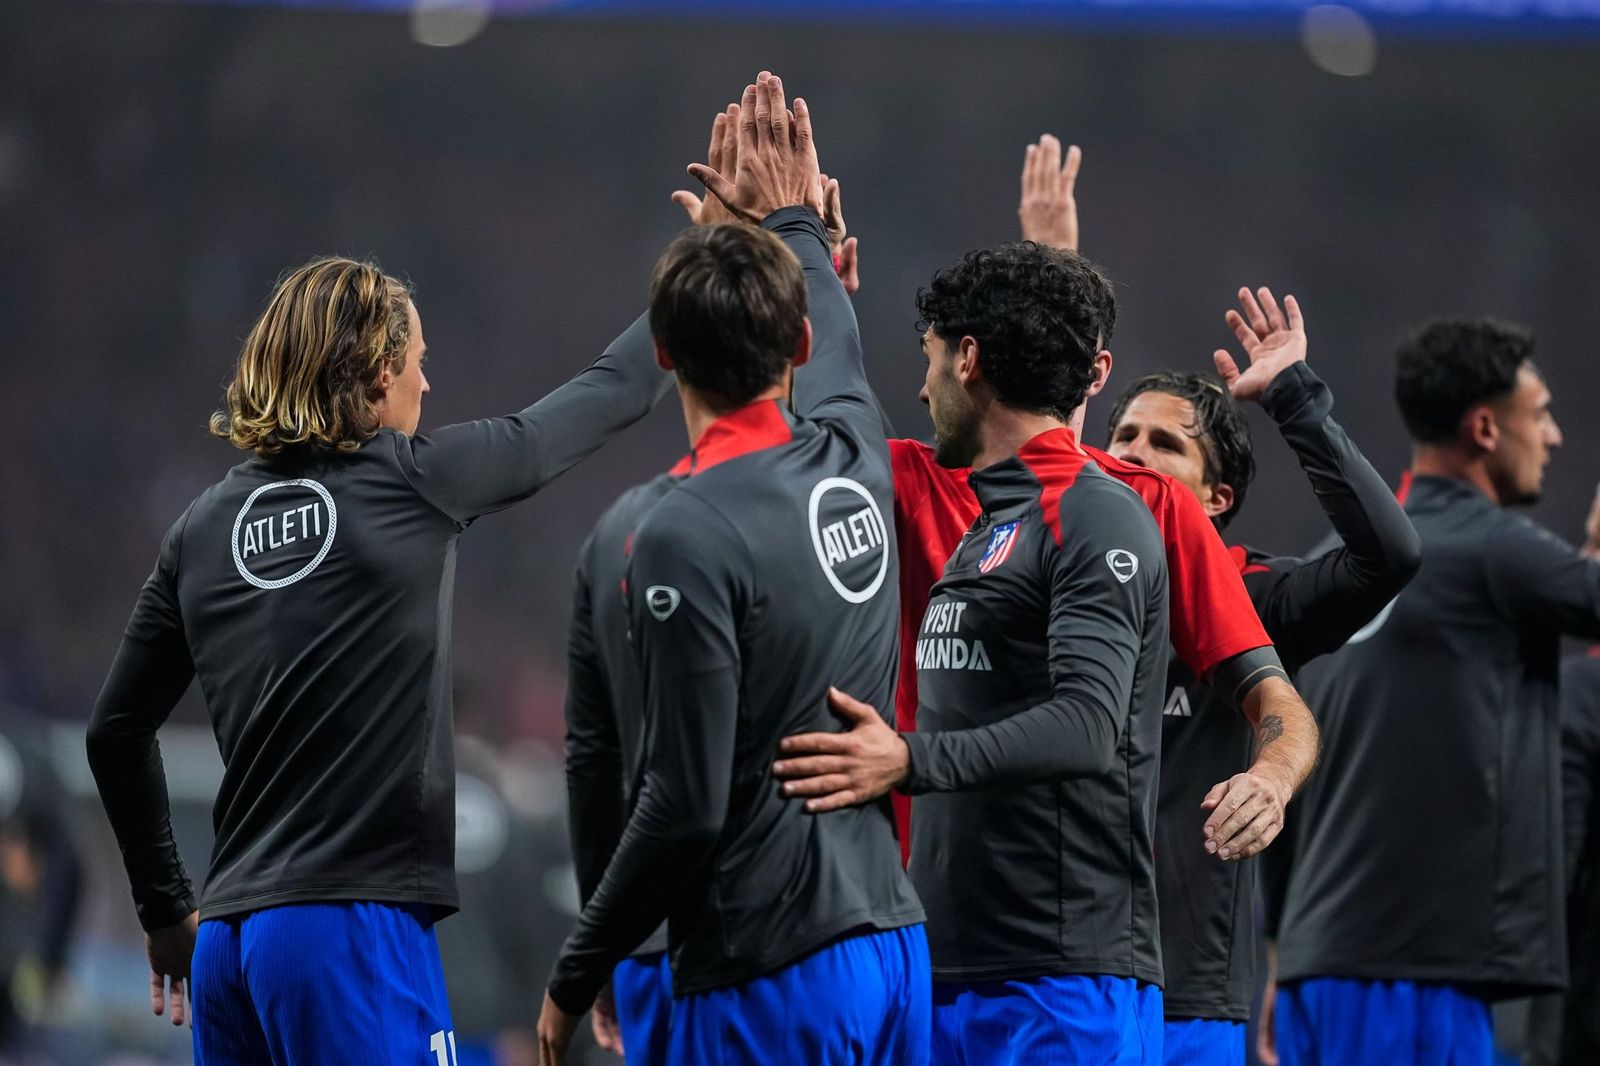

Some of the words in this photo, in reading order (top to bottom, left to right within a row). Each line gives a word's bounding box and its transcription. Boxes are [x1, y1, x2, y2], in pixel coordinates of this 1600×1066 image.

[243, 502, 321, 559] ATLETI
[822, 506, 882, 567] ATLETI
[924, 602, 967, 633] VISIT
[916, 638, 993, 671] WANDA
